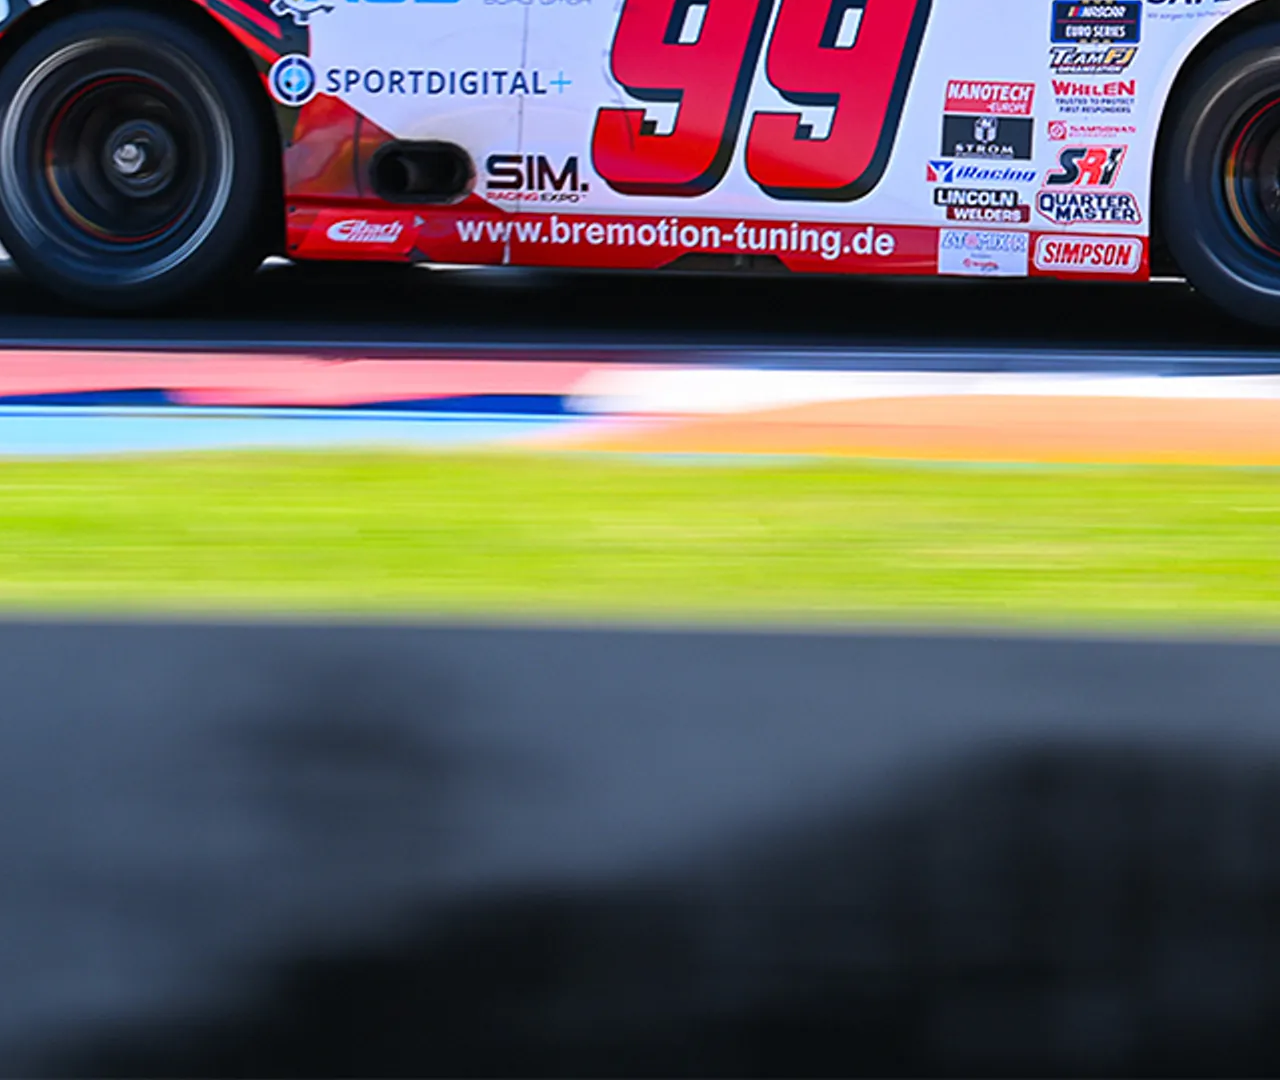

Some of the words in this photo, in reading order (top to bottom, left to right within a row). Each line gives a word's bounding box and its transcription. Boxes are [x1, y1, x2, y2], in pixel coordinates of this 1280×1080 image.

[1081, 6, 1126, 17] NASCAR
[1065, 25, 1091, 37] EURO
[1093, 25, 1125, 37] SERIES
[948, 83, 1031, 101] NANOTECH
[955, 144, 1014, 154] STROM
[955, 166, 1037, 182] iRacing
[486, 192, 539, 201] RACING
[540, 192, 580, 203] EXPO
[937, 190, 1015, 207] LINCOLN
[1040, 193, 1131, 212] QUARTER
[954, 208, 1022, 221] WELDERS
[1056, 206, 1136, 221] MASTER
[456, 215, 895, 259] www.bremotion-tuning.de
[1043, 242, 1133, 265] SIMPSON
